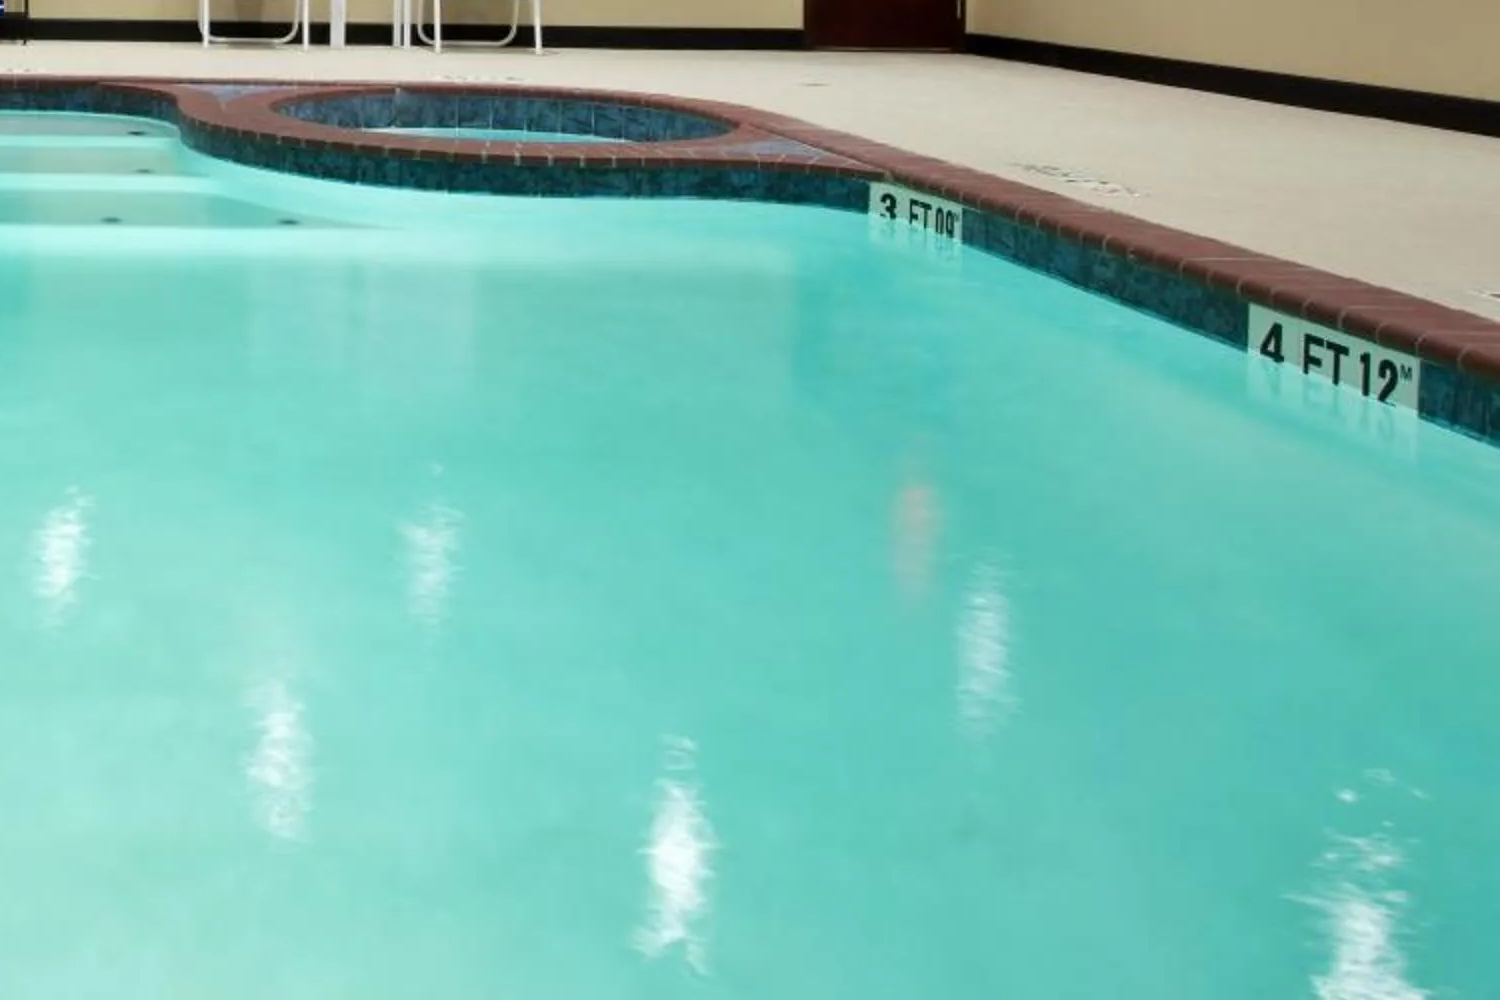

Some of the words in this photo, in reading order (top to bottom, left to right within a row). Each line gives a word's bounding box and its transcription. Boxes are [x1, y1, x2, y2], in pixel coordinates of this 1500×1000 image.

[880, 192, 897, 220] 3
[909, 198, 933, 229] FT
[1260, 322, 1285, 363] 4
[1304, 333, 1349, 386] FT
